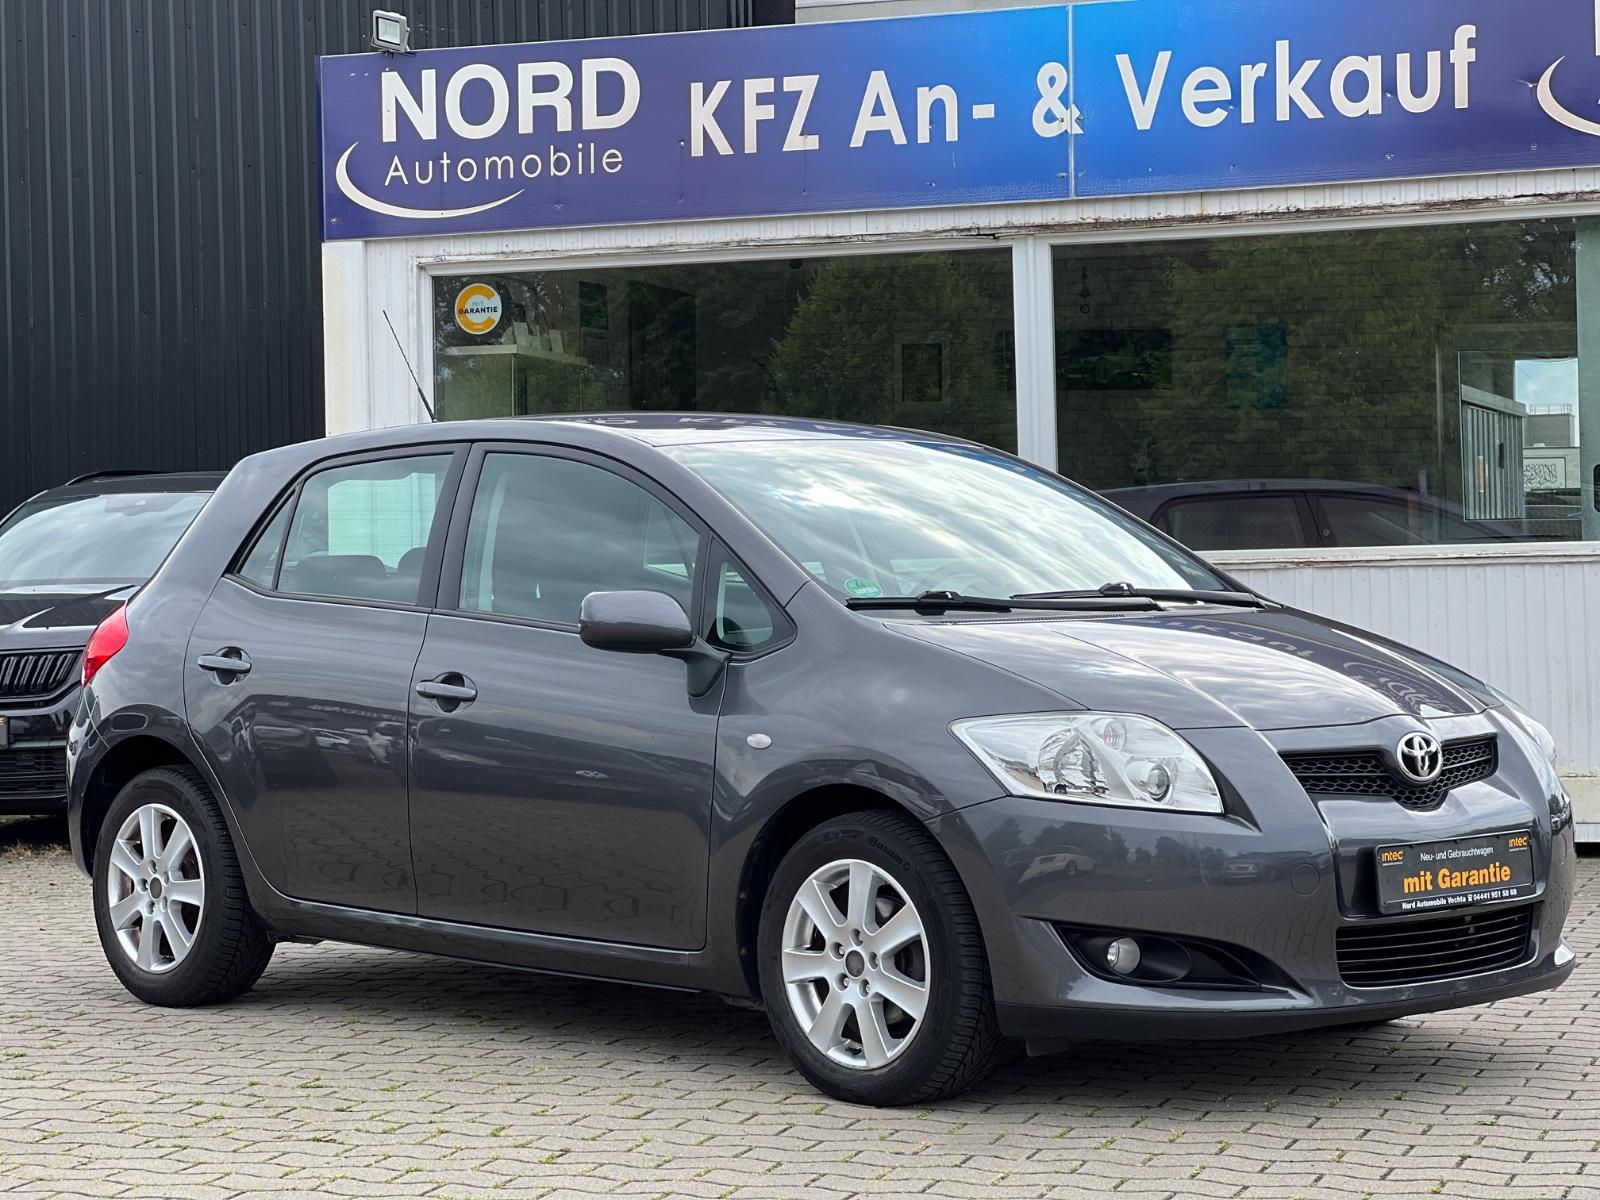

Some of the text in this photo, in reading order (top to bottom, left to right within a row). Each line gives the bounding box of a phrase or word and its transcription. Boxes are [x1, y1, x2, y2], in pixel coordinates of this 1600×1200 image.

[381, 57, 641, 143] NORD
[690, 24, 1478, 158] KFZ An- & Verkauf
[384, 143, 623, 187] Automobile
[458, 306, 498, 315] GARANTIE
[1420, 846, 1494, 862] Neu- und Gebrauchtwagen
[1403, 862, 1511, 894] mit Garantie
[1402, 901, 1416, 910] Nord
[1416, 898, 1447, 908] Automobile
[1447, 895, 1466, 905] Vechta
